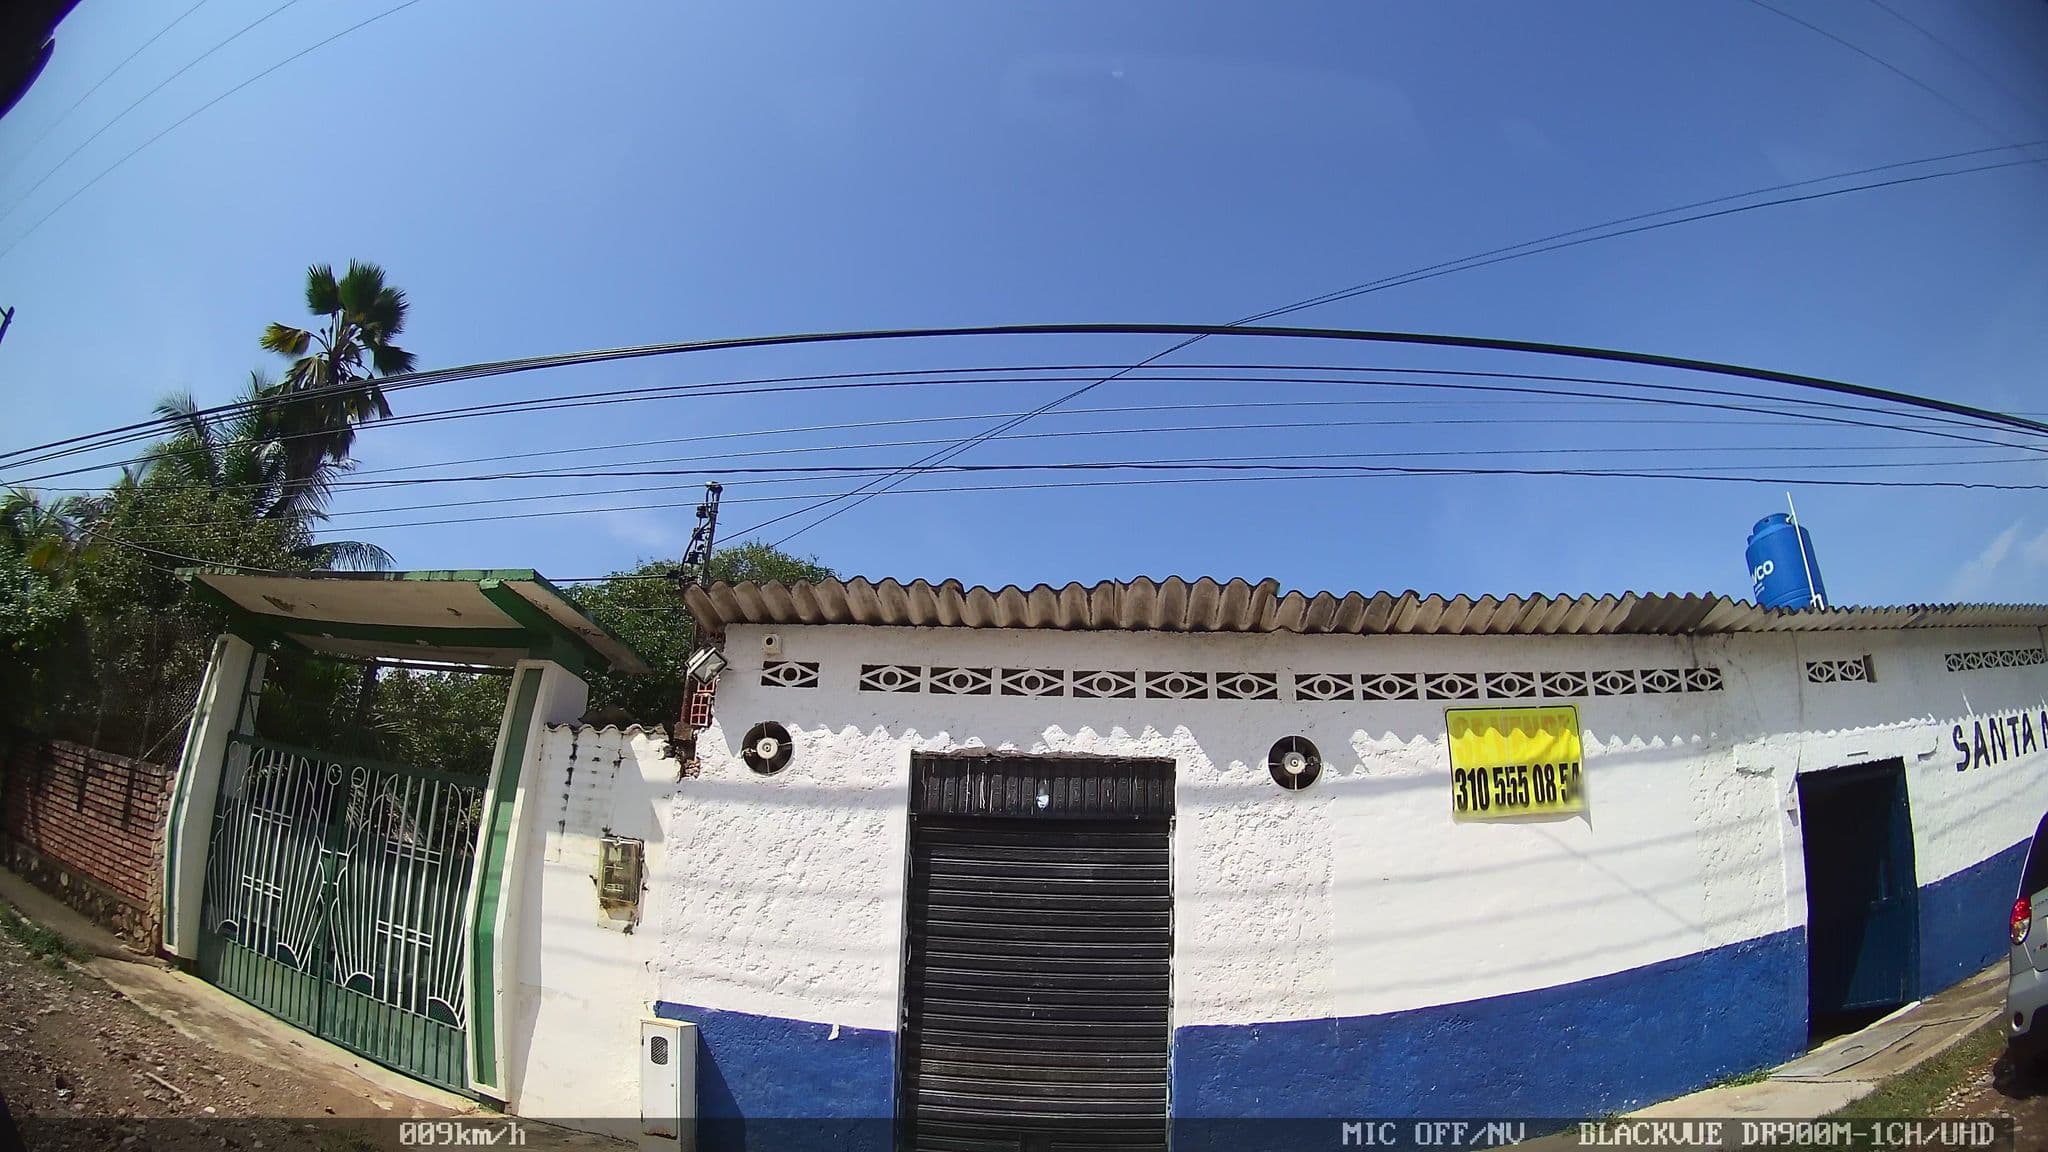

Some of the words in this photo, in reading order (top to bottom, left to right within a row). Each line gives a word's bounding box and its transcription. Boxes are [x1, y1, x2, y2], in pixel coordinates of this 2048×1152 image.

[1952, 712, 2037, 773] SANTA
[1455, 767, 1490, 811] 310
[1493, 765, 1530, 808] 555
[1532, 763, 1557, 805] 08
